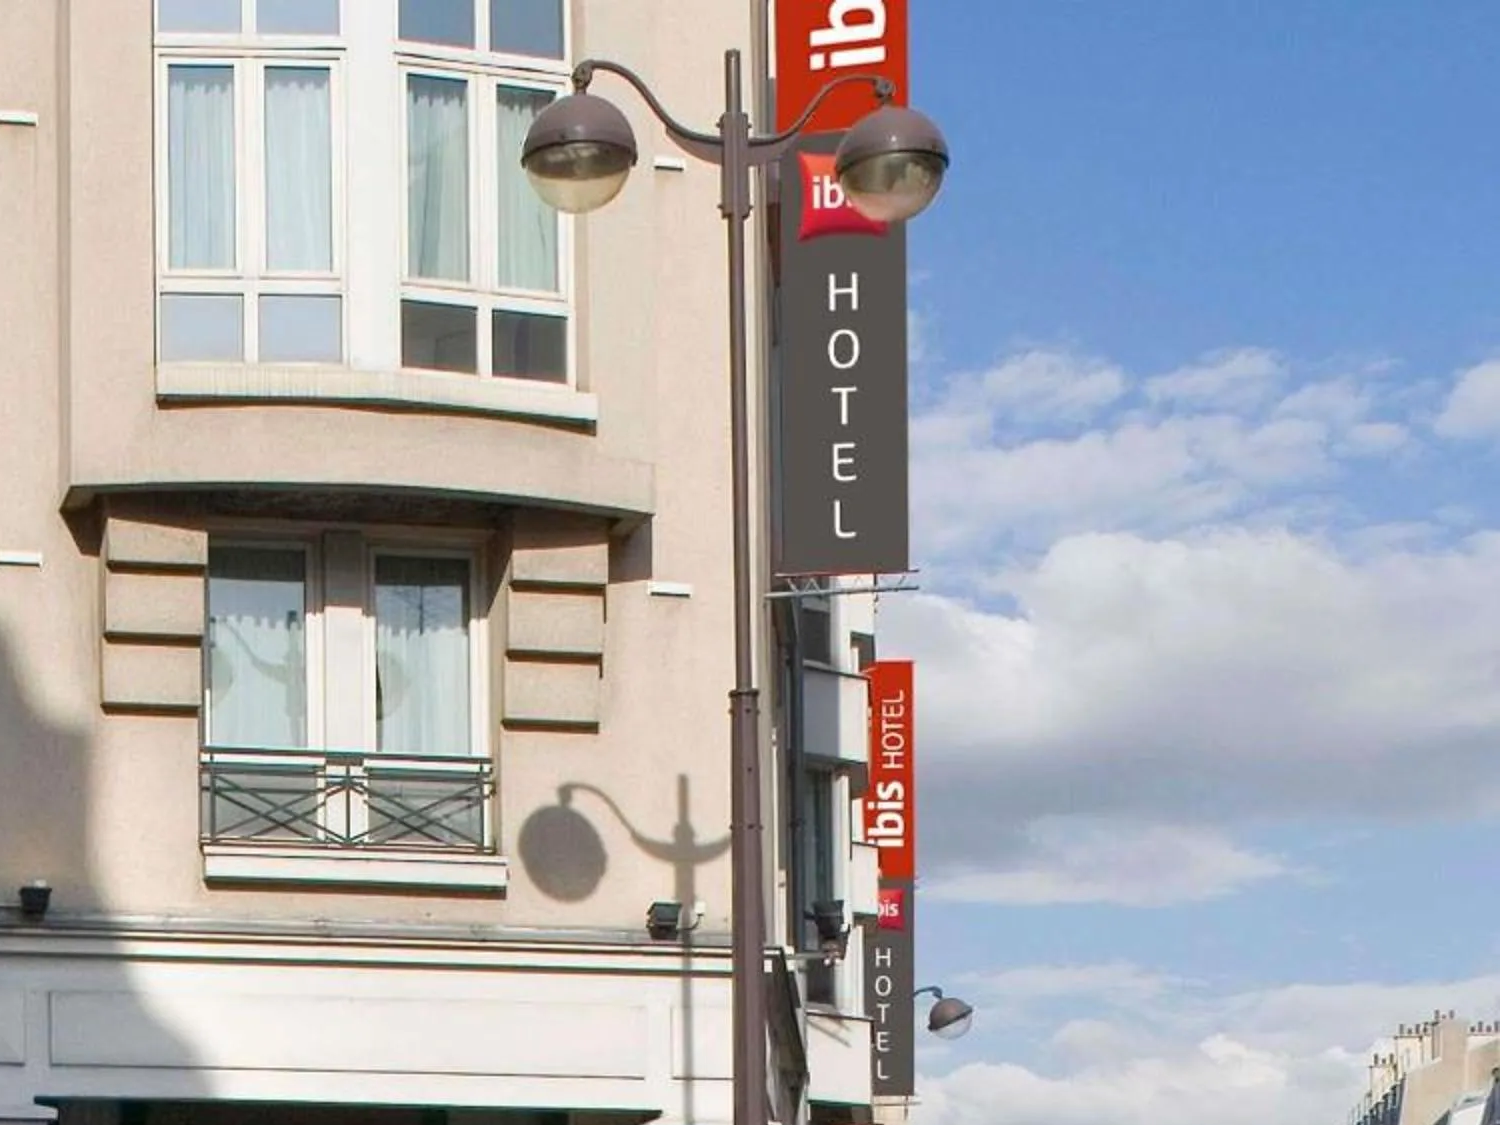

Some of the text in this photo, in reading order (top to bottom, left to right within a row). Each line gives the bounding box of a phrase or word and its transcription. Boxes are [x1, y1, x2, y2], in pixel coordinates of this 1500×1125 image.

[828, 272, 860, 540] HOTEL
[867, 689, 905, 847] ibis HOTEL
[875, 948, 892, 1080] HOTEL
